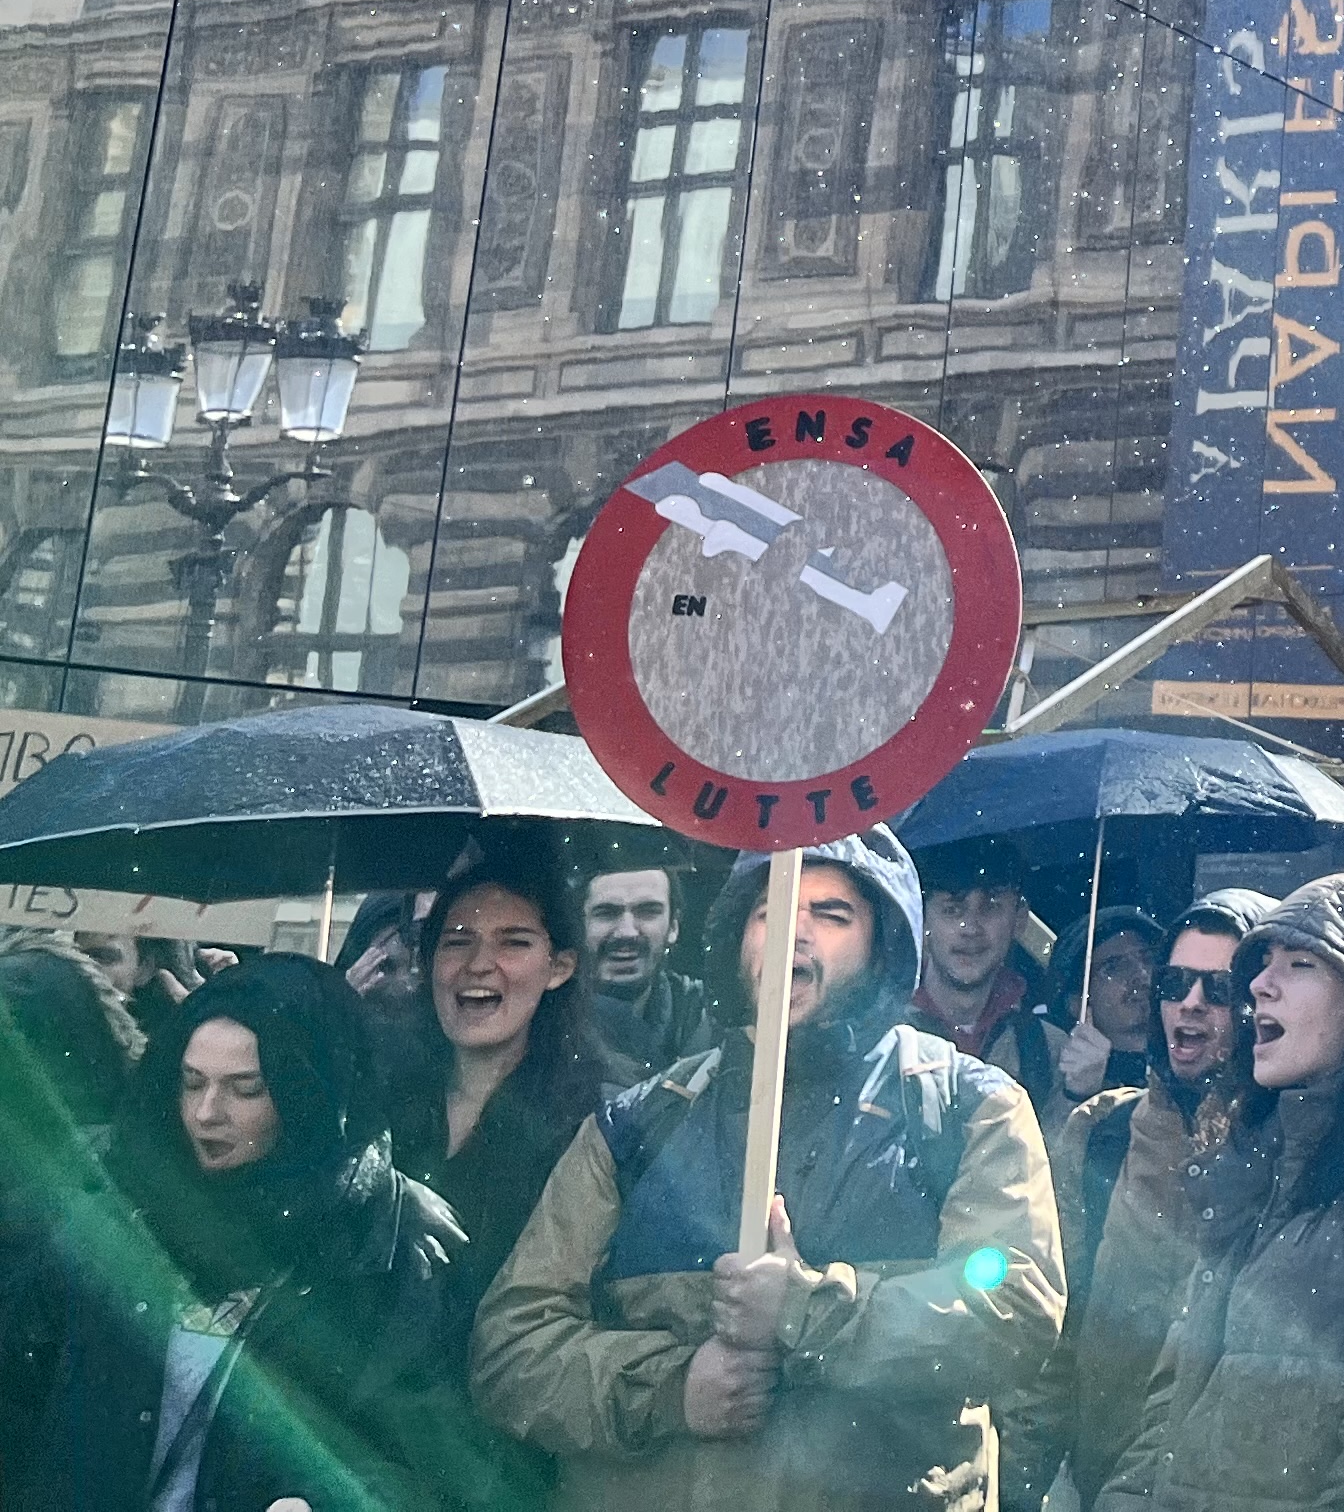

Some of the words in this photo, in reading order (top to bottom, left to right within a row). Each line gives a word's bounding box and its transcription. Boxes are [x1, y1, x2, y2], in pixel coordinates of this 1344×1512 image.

[745, 410, 915, 467] ENSA
[671, 594, 708, 618] EN
[650, 762, 879, 829] LUTTE
